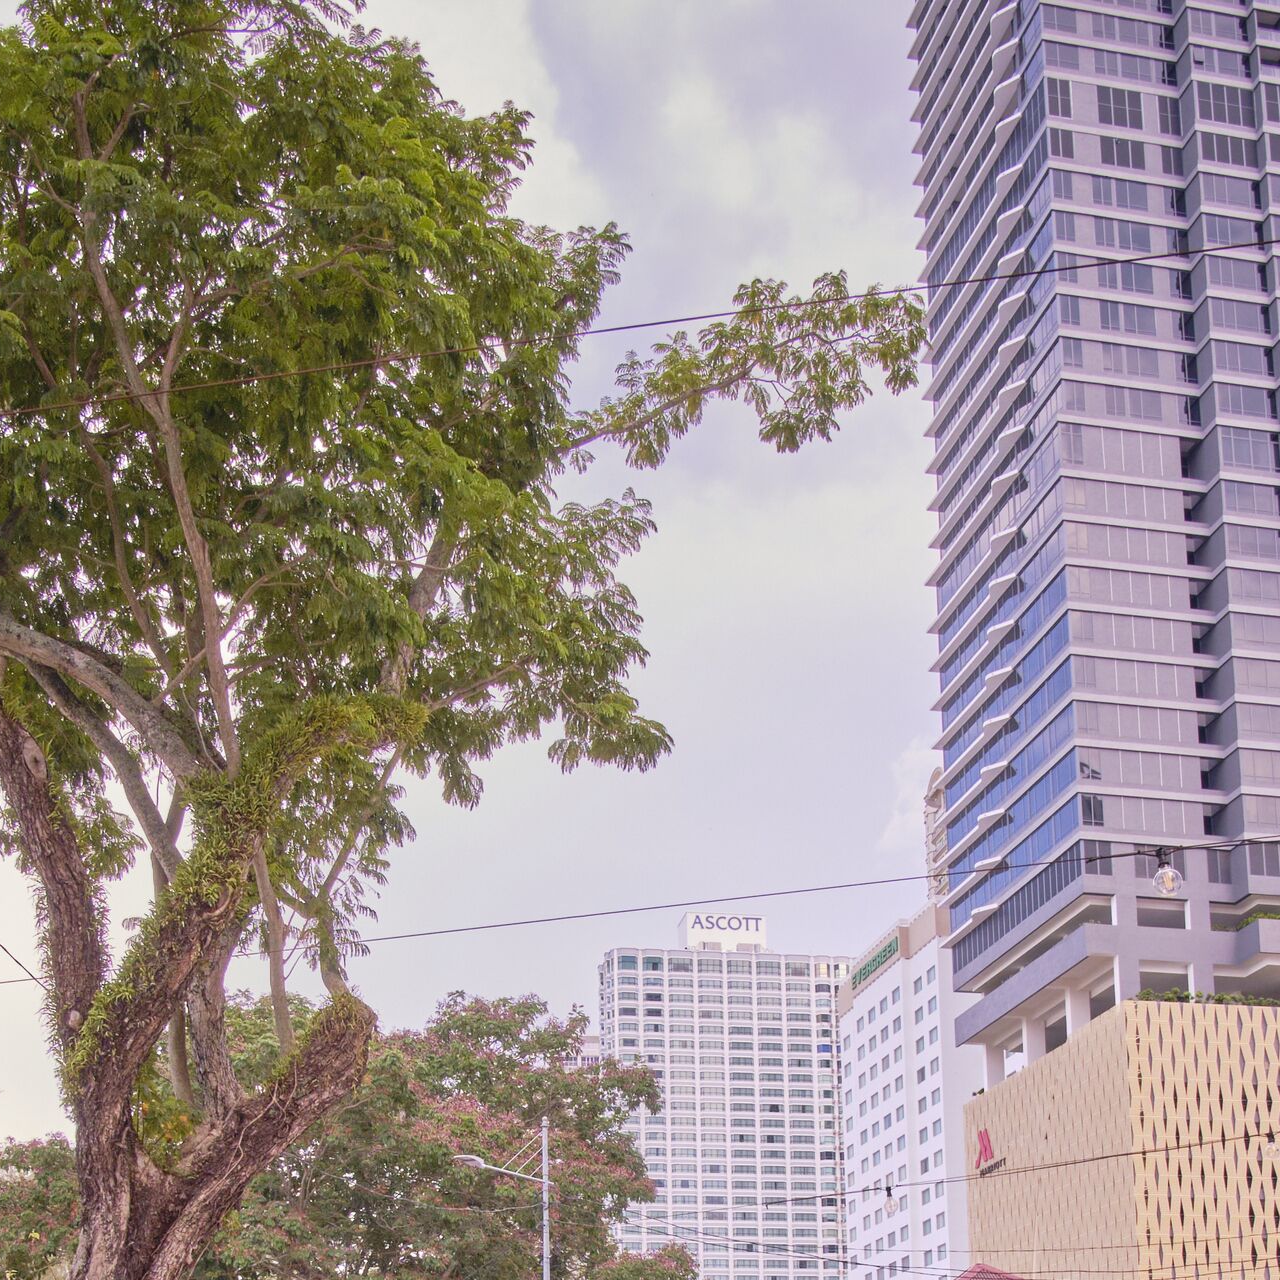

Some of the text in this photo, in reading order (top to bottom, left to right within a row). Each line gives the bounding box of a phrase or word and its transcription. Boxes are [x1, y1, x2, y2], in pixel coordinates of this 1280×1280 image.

[691, 915, 762, 931] ASCOTT
[851, 936, 898, 990] EVERGREEN
[980, 1157, 1006, 1178] MARRIOTT
